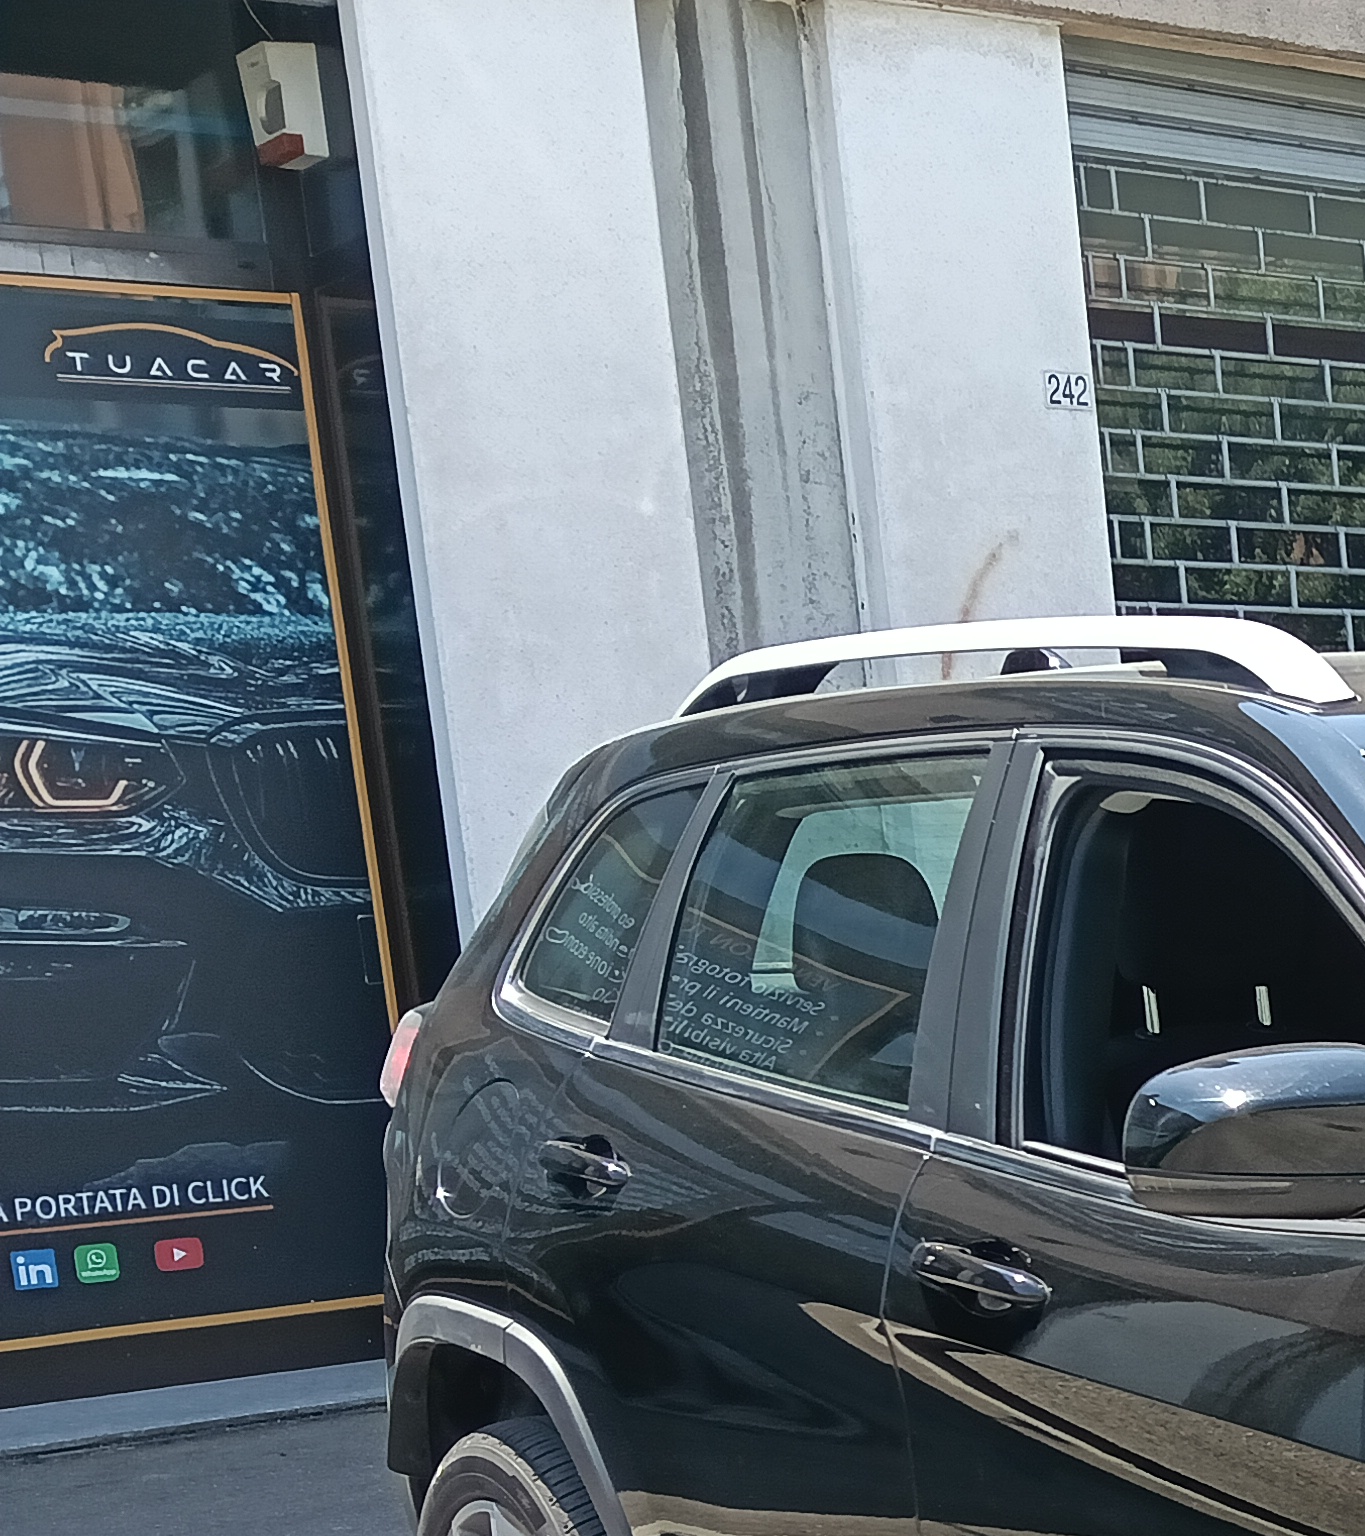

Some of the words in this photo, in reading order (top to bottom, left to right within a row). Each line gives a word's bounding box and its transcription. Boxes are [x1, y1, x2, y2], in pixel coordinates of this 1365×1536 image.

[65, 350, 282, 384] TUACAR
[1047, 373, 1089, 407] 242
[14, 1187, 147, 1222] PORTATA
[152, 1183, 180, 1209] DI
[187, 1175, 270, 1205] CLICK
